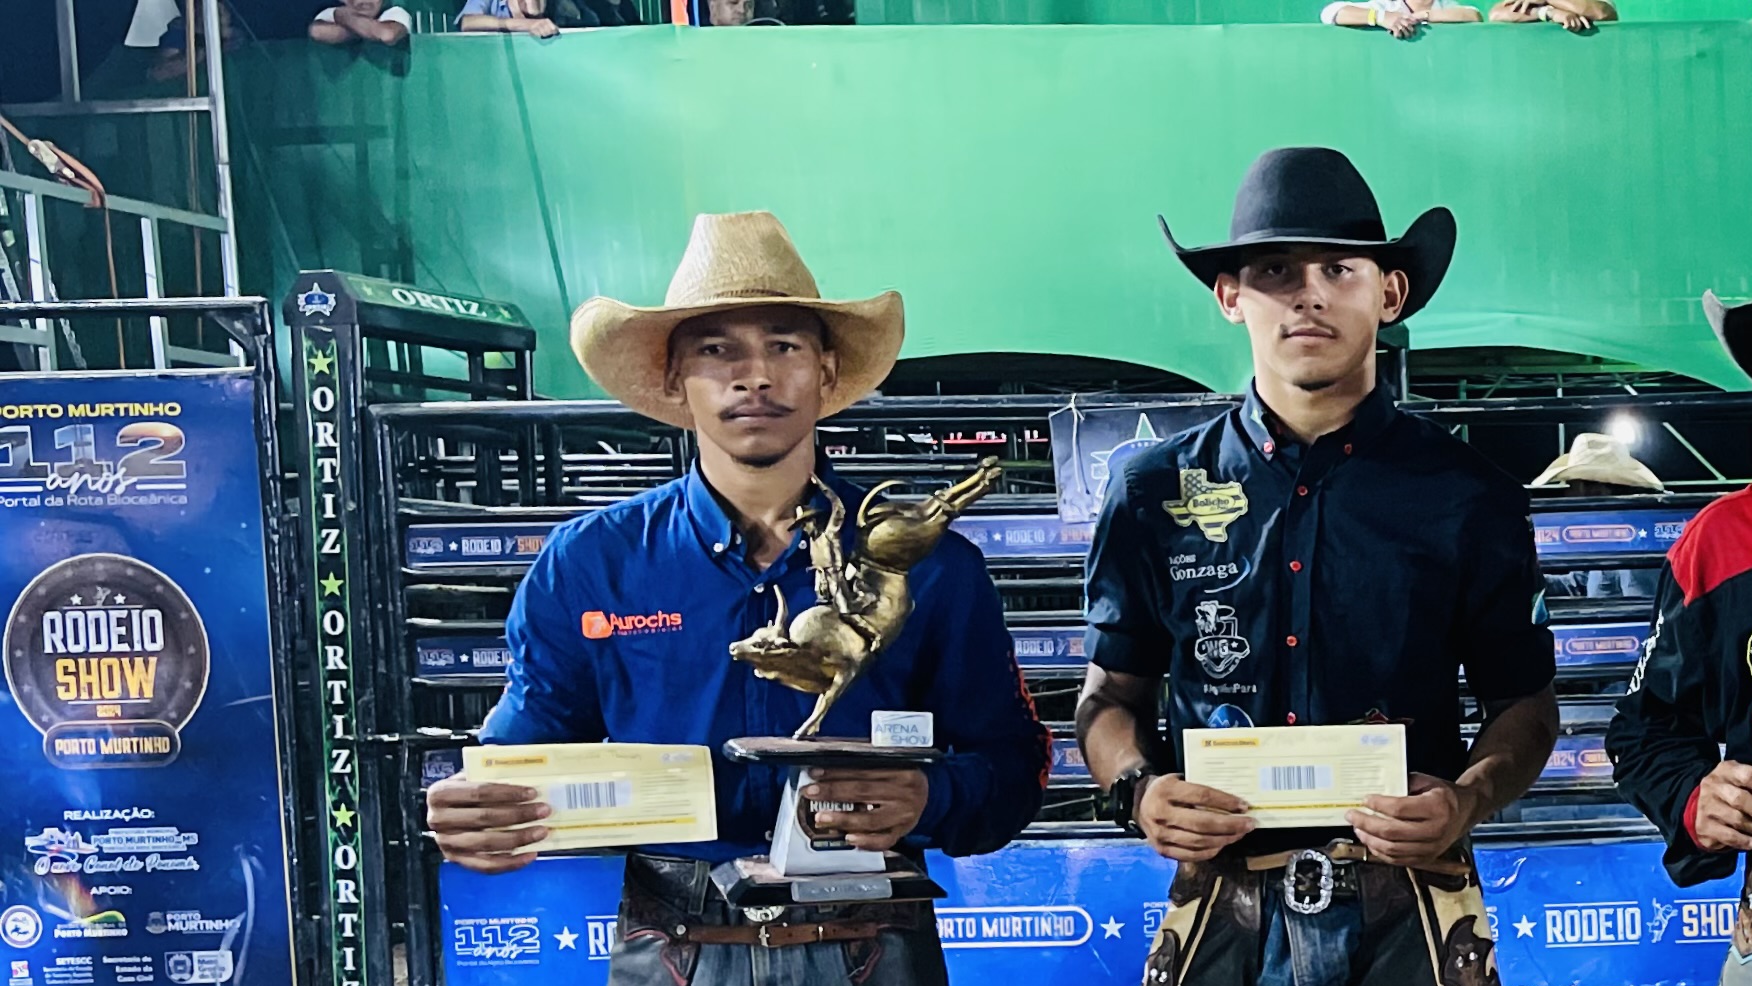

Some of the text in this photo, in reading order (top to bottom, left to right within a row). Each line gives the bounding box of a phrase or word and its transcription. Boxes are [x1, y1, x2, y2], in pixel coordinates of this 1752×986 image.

[391, 288, 487, 318] ORTIZ
[0, 402, 182, 418] ORTO MURTINHO
[312, 386, 341, 554] ORTIZ
[46, 467, 138, 494] anos
[44, 494, 64, 505] da
[67, 493, 103, 505] Rota
[107, 493, 188, 505] Bioceânica
[1005, 529, 1045, 544] RODEIO
[461, 538, 501, 555] RODEIO
[1170, 562, 1238, 581] Gonzaga
[610, 610, 682, 630] Aurochs
[43, 609, 164, 653] RODEIO
[472, 650, 512, 667] RODEIO
[55, 657, 158, 700] SHOW
[322, 610, 352, 774] ORTIZ
[874, 723, 919, 734] ARENA
[55, 736, 171, 755] PORTO MURTINHO
[890, 735, 932, 746] SHOW
[64, 807, 155, 822] REALIZAÇÃO:
[93, 835, 124, 845] PORTO
[90, 886, 132, 896] APOIO:
[167, 912, 201, 921] PORTO
[168, 919, 241, 931] MURTINHO
[1545, 903, 1742, 943] RODEIO SHO
[982, 916, 1075, 938] MURTINHO
[455, 924, 540, 951] 112
